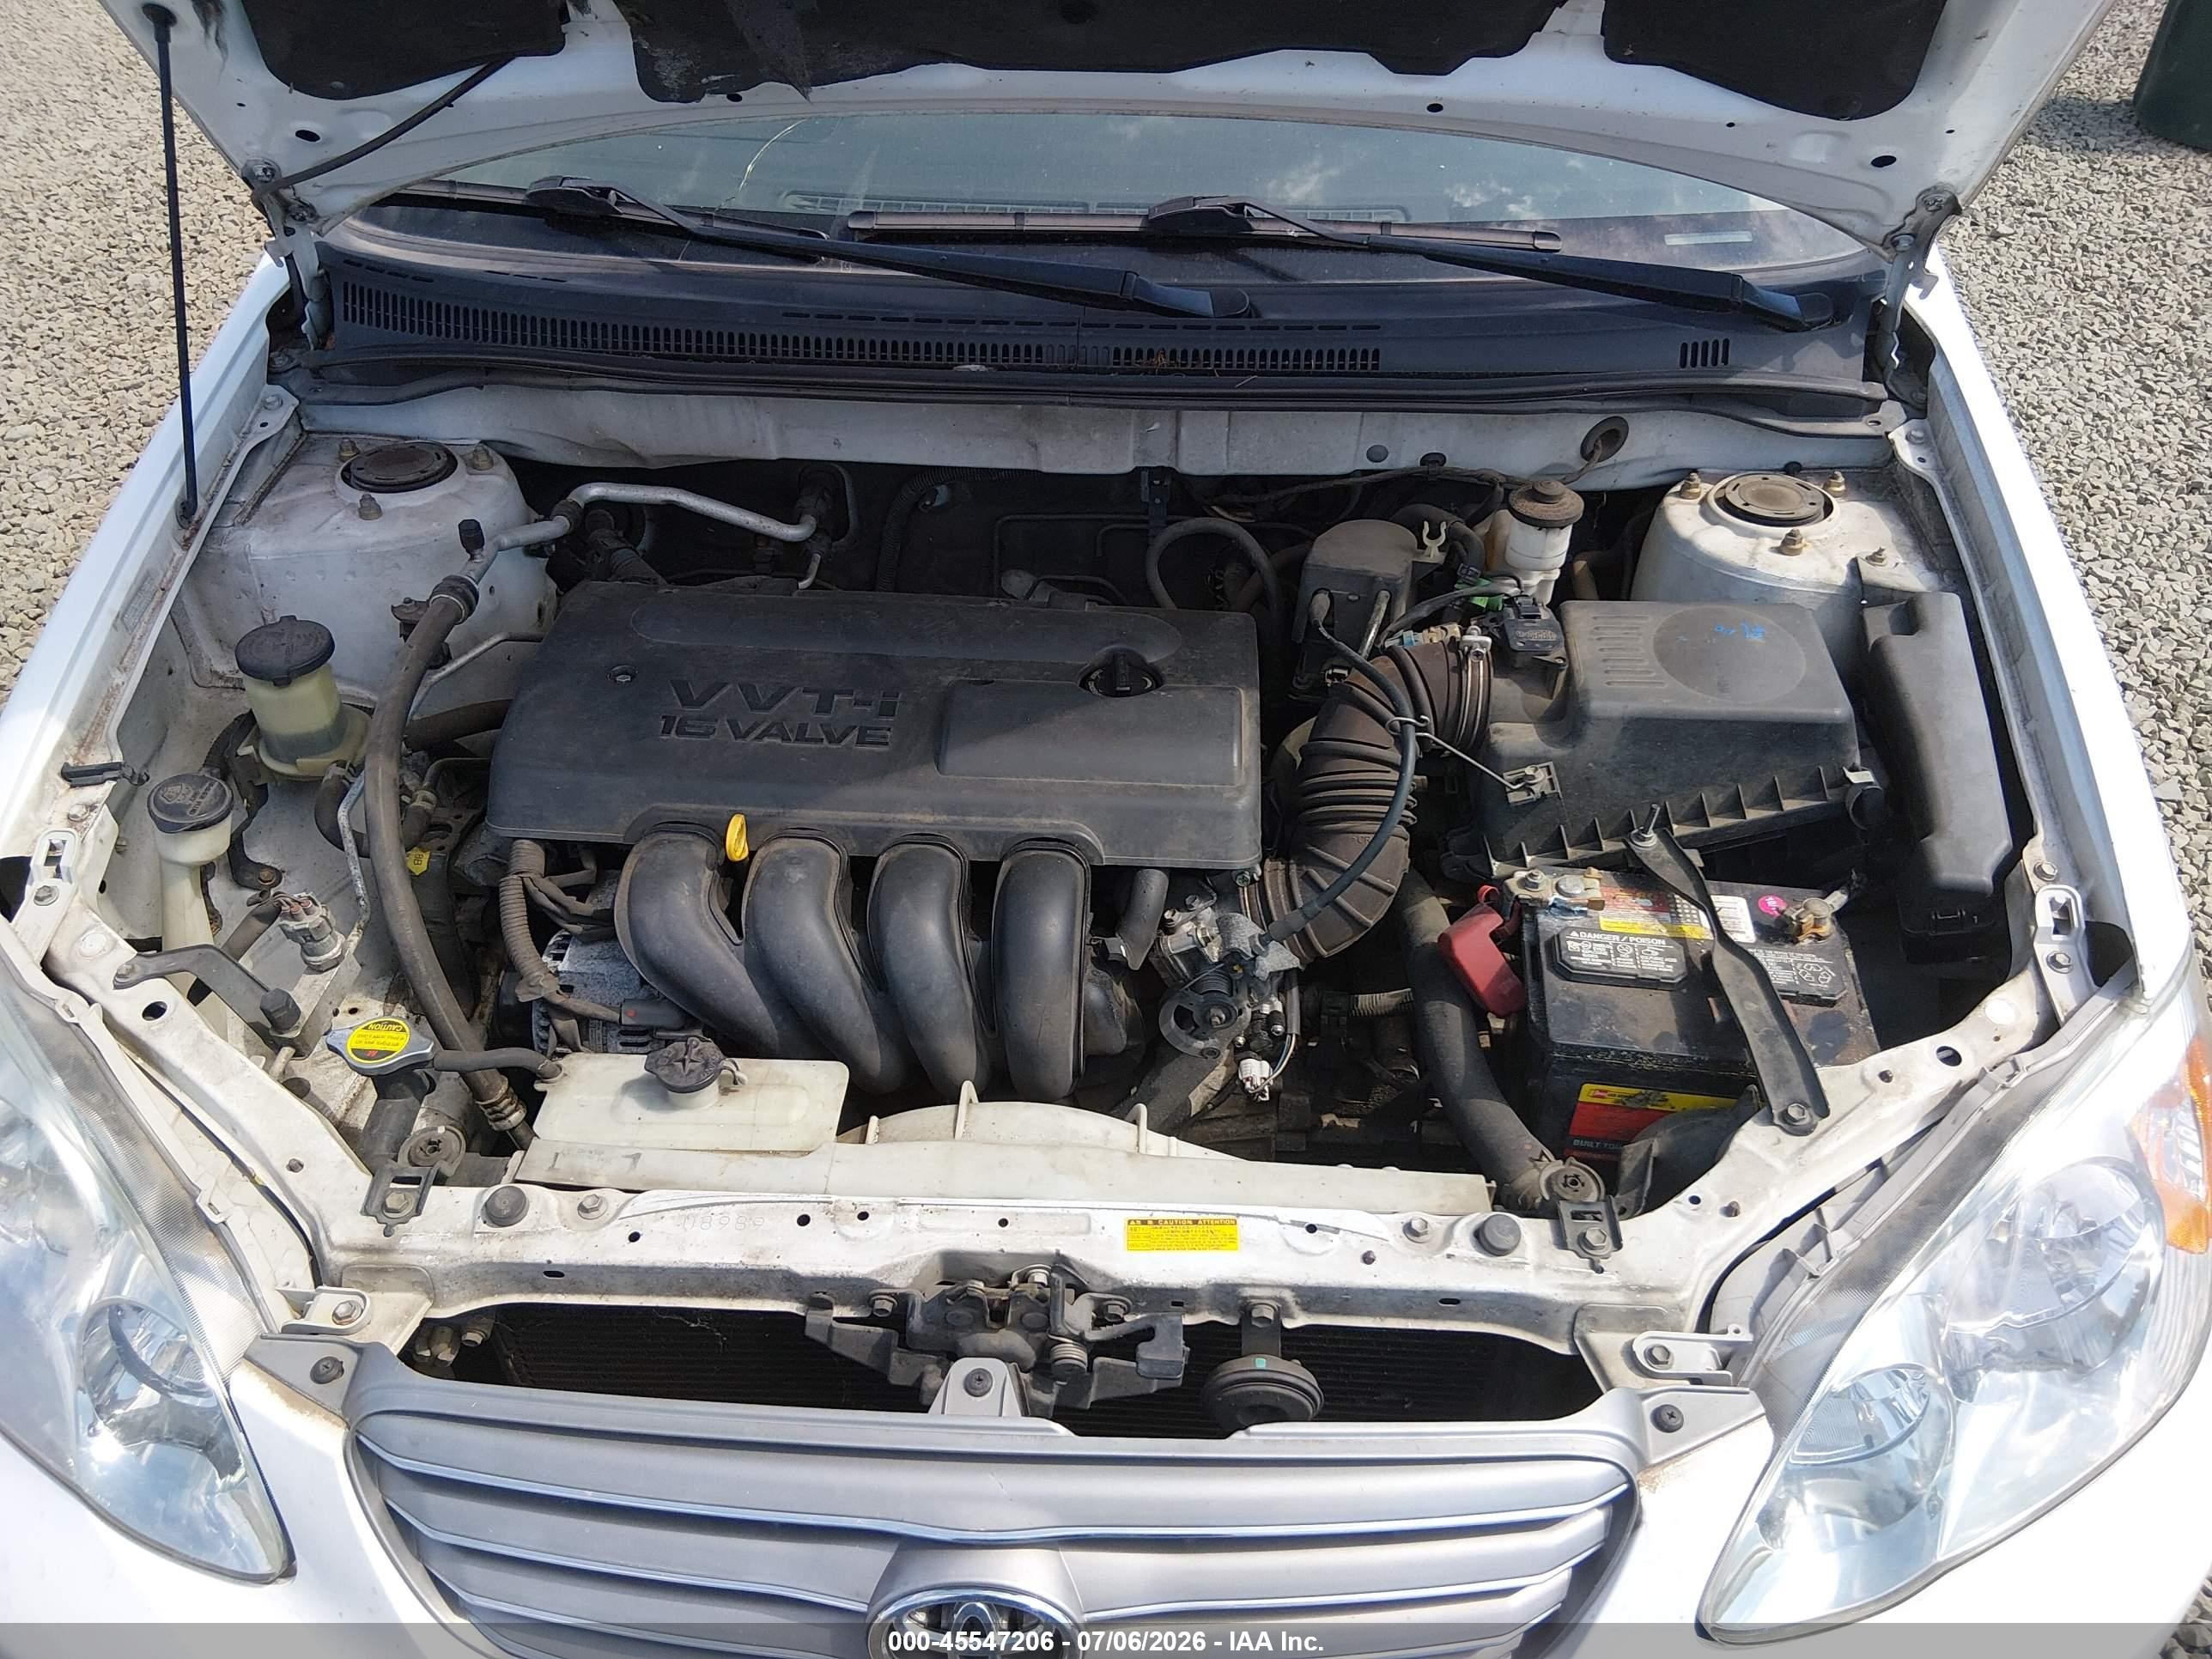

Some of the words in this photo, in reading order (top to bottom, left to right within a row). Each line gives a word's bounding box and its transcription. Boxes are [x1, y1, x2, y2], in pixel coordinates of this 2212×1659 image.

[670, 679, 900, 720] VVT-i
[659, 714, 718, 740] 16
[726, 719, 892, 749] VALVE
[1579, 931, 1620, 942] DANGER
[1629, 936, 1666, 946] POISON
[368, 1022, 404, 1033] CAUTION
